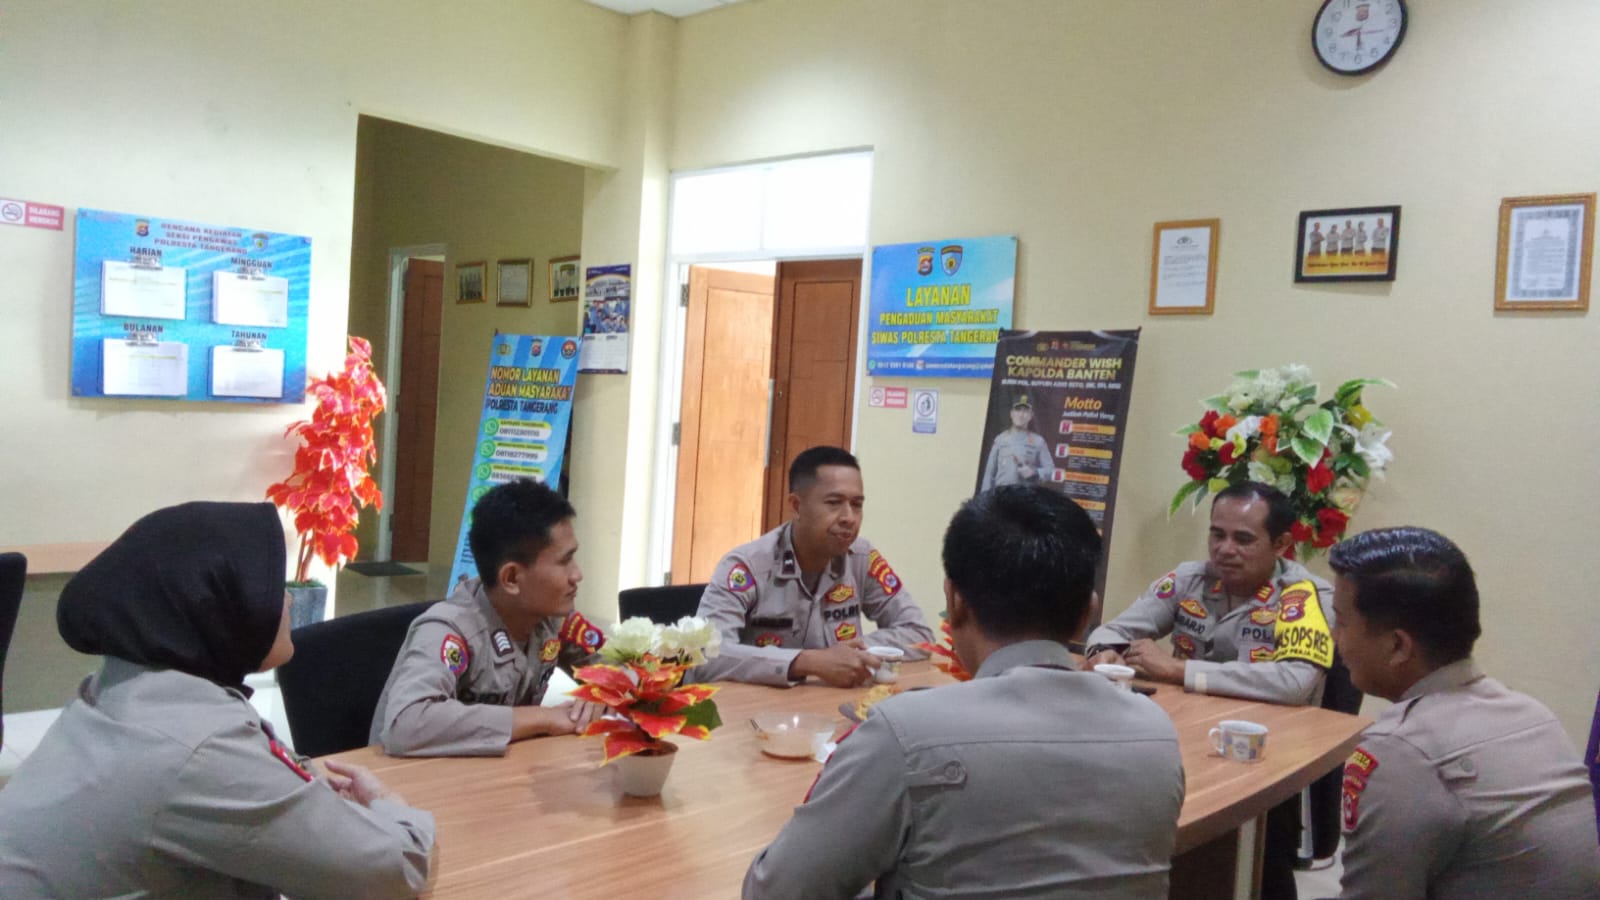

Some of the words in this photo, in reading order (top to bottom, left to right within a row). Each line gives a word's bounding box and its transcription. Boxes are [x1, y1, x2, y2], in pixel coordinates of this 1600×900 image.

[130, 245, 162, 257] HARIAN
[231, 257, 273, 269] MINGGUAN
[905, 283, 971, 307] LAYANAN
[879, 311, 932, 326] PENGADUAN
[936, 308, 999, 325] MASYARAKAT
[123, 322, 164, 333] BULANAN
[231, 330, 267, 340] TAHUNAN
[871, 330, 899, 344] SIWAS
[901, 329, 946, 344] POLRESTA
[950, 329, 1000, 344] TANGERAN
[1005, 354, 1087, 369] COMMANDER
[1089, 357, 1123, 369] WISH
[491, 366, 521, 380] NOMOR
[522, 367, 560, 383] LAYANAN
[1007, 366, 1065, 379] KAPOLDA
[1066, 368, 1117, 380] BANTEN
[488, 382, 518, 397] ADUAN
[519, 384, 572, 401] MASYARAKAT
[486, 398, 518, 411] POLRESTA
[519, 400, 559, 415] TANGERANG
[1063, 396, 1103, 410] Motto
[823, 604, 860, 621] POLRI
[1242, 627, 1274, 640] POL
